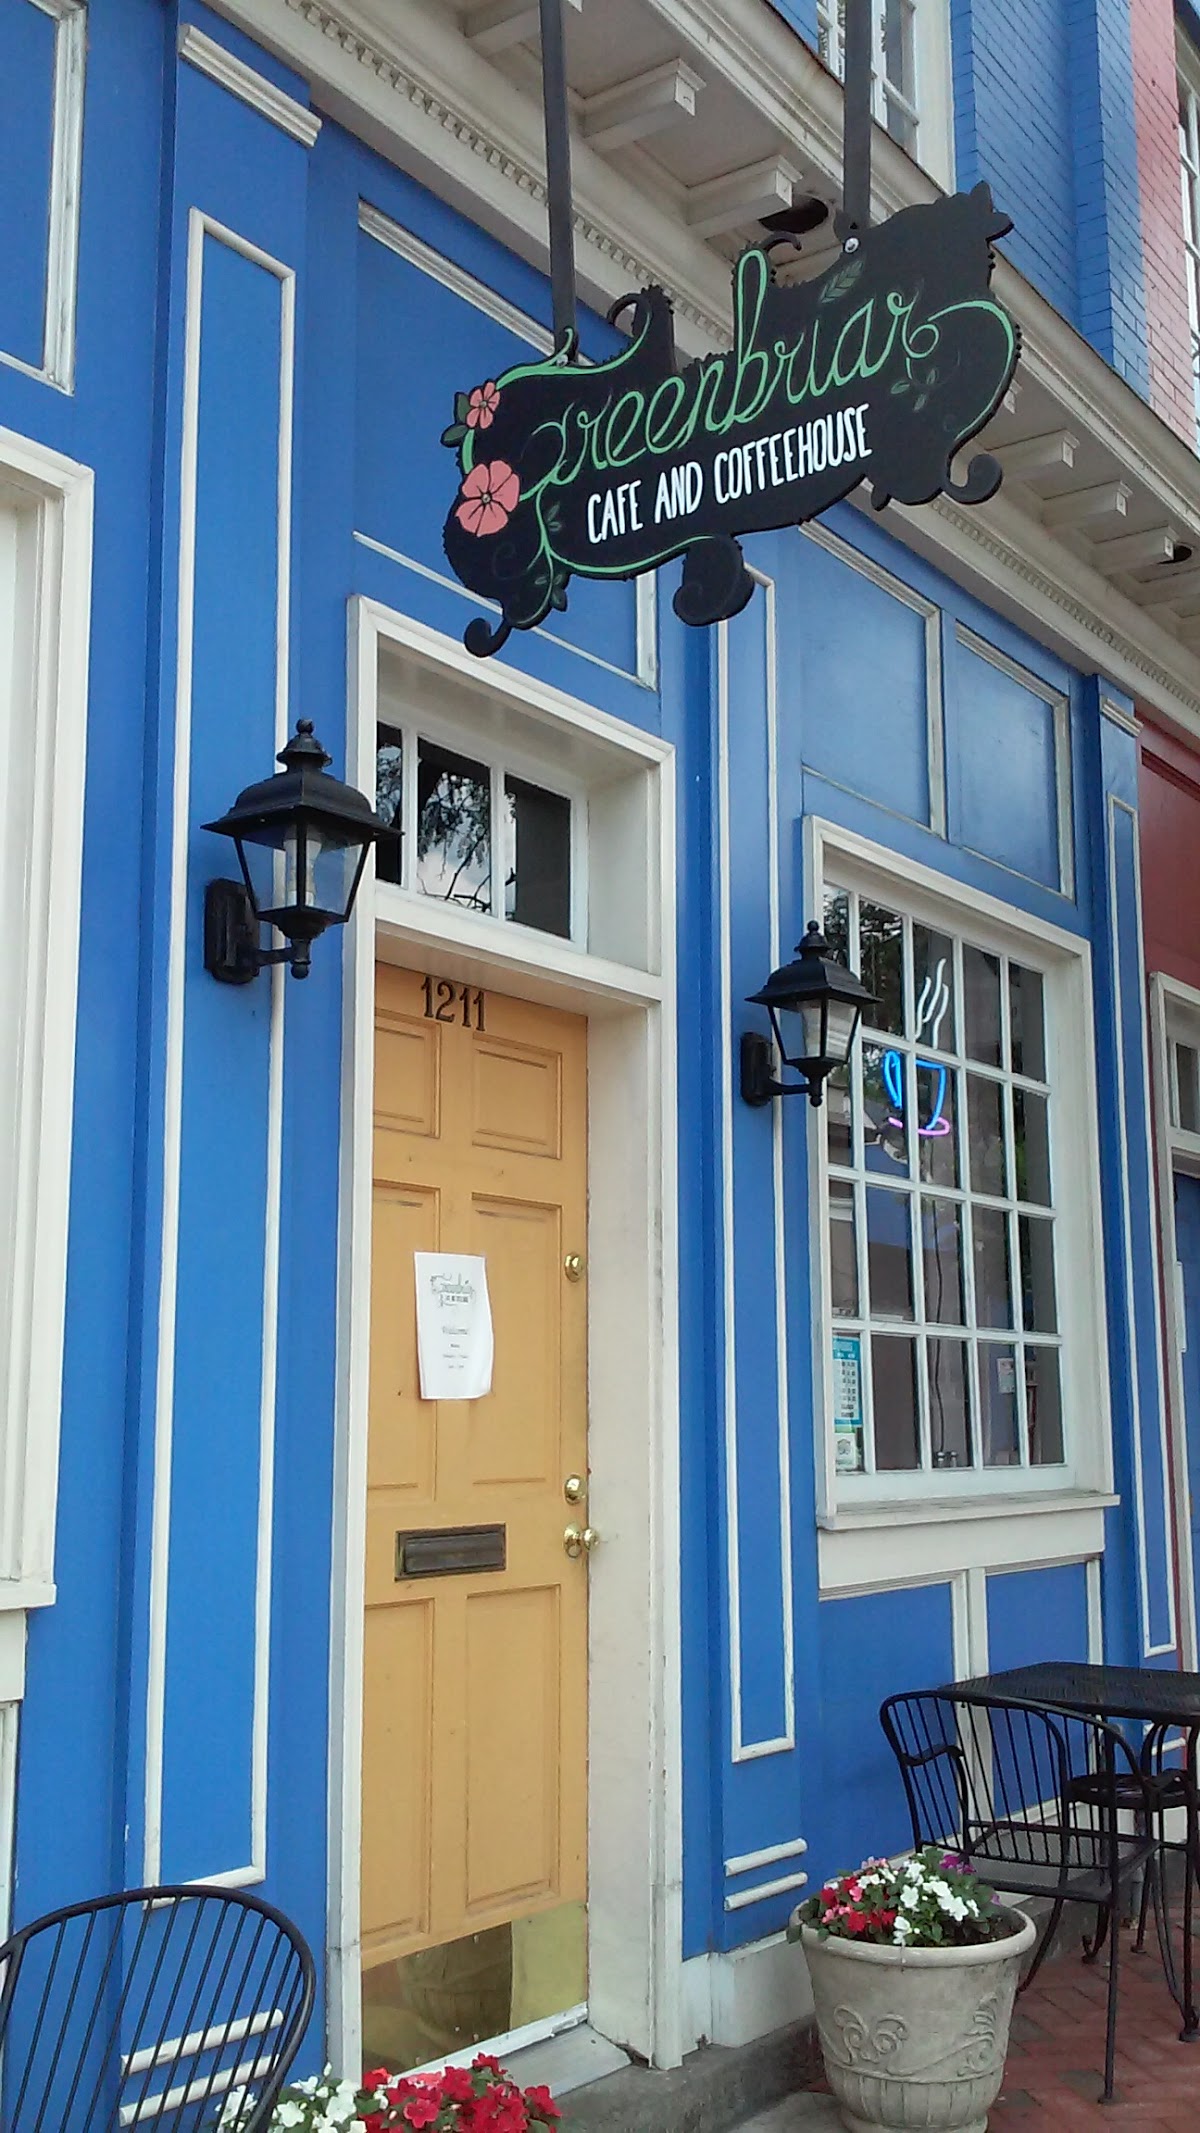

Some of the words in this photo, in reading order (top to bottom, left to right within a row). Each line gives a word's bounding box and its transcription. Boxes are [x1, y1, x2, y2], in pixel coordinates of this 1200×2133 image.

[587, 479, 644, 544] CAFE
[654, 460, 704, 524] AND
[713, 403, 873, 504] COFFEEHOUSE
[420, 976, 486, 1032] 1211
